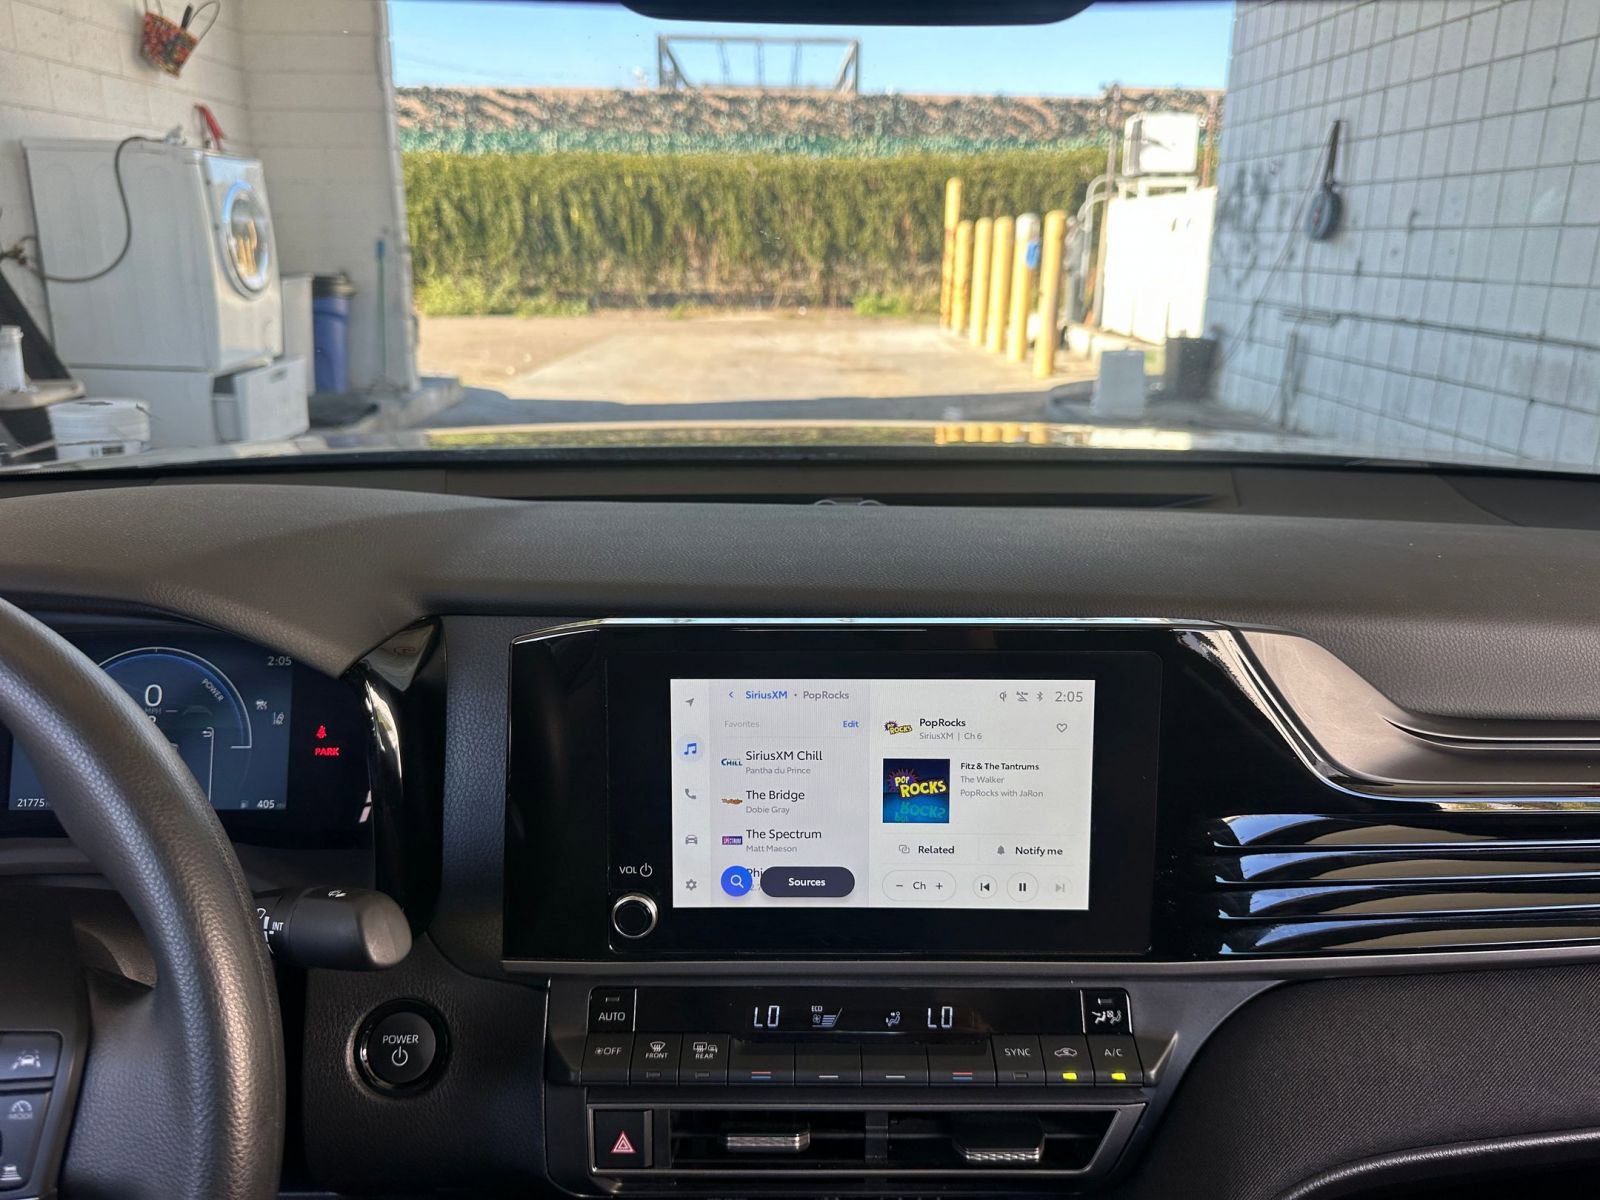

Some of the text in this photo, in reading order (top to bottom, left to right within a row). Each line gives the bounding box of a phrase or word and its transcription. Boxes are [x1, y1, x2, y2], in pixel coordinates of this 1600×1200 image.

[268, 656, 292, 666] 2:05
[145, 684, 162, 706] 0
[202, 678, 224, 702] POWER
[746, 690, 850, 702] SiriusXM PopRocks
[1055, 690, 1084, 702] 2:05
[724, 720, 760, 728] Favorites
[842, 720, 860, 728] Edit
[920, 718, 966, 728] PopRocks
[920, 732, 954, 740] SiriusXM
[964, 732, 976, 740] Ch
[976, 732, 982, 740] 6
[314, 748, 340, 756] PARK
[746, 750, 823, 760] SiriusXM Chill
[746, 766, 811, 774] Pantha du Prince
[960, 762, 974, 770] Fitz
[1000, 762, 1040, 770] Tantrums
[960, 776, 1005, 784] The Walker
[900, 780, 946, 798] ROCKS
[960, 790, 999, 798] PopRocks
[1019, 790, 1044, 798] JaRon
[746, 790, 805, 802] The Bridge
[17, 798, 45, 808] 21775
[256, 800, 275, 808] 405
[746, 806, 790, 816] Dobie Gray
[746, 829, 822, 841] The Spectrum
[918, 846, 954, 854] Related
[1015, 846, 1046, 857] Notify
[619, 866, 638, 874] VOL
[788, 878, 826, 887] Sources
[912, 881, 926, 890] Ch
[272, 921, 284, 931] INT
[598, 1012, 626, 1022] AUTO
[382, 1034, 419, 1044] POWER
[604, 1046, 622, 1056] OFF
[1004, 1048, 1030, 1056] SYNC
[1104, 1048, 1122, 1057] A/C
